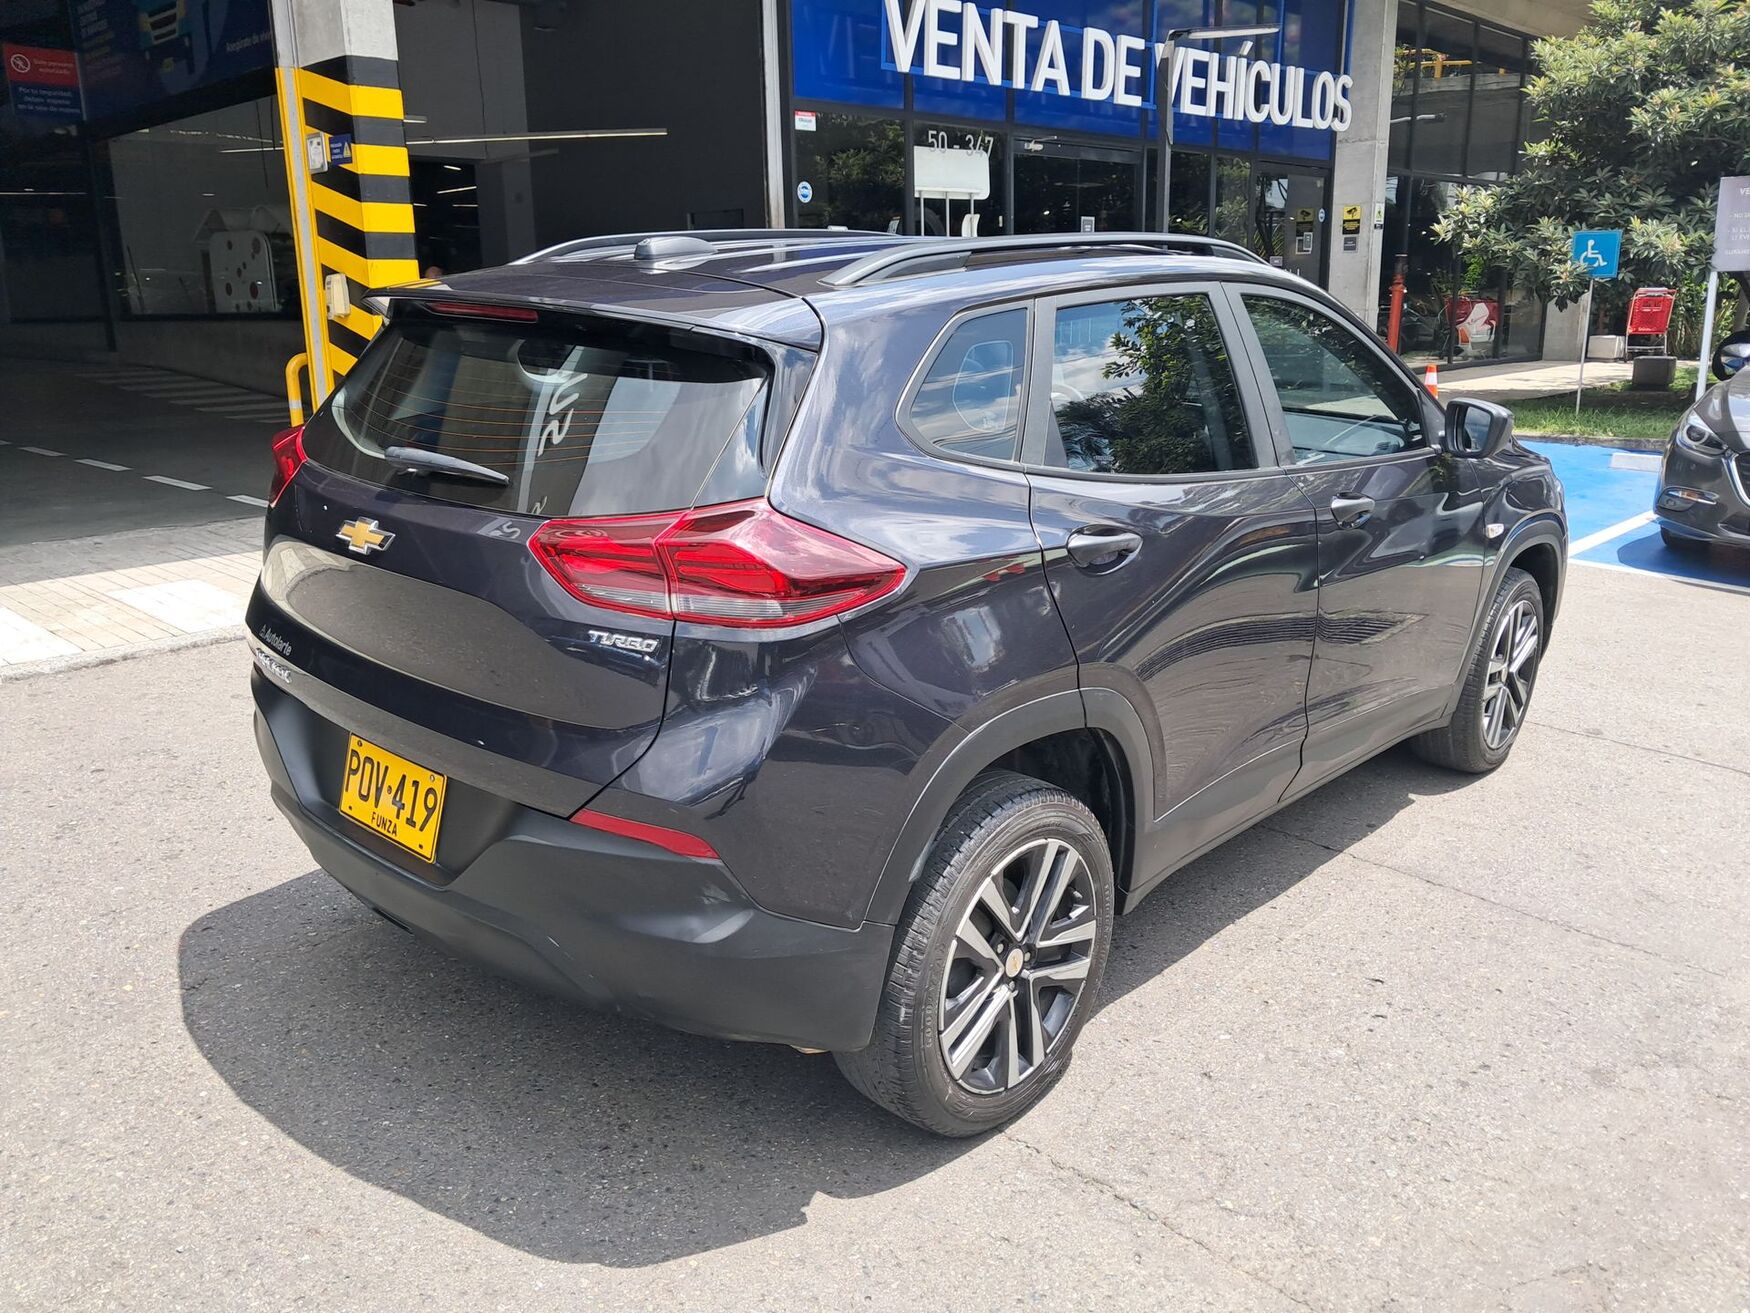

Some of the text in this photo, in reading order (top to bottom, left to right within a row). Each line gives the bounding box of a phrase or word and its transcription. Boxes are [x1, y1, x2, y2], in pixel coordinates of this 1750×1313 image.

[885, 0, 1354, 133] VENTA DE VEHÍCULOS
[928, 130, 948, 153] 50
[264, 627, 293, 656] Autolarte
[587, 630, 658, 652] TURBO
[371, 811, 398, 837] FUNZA
